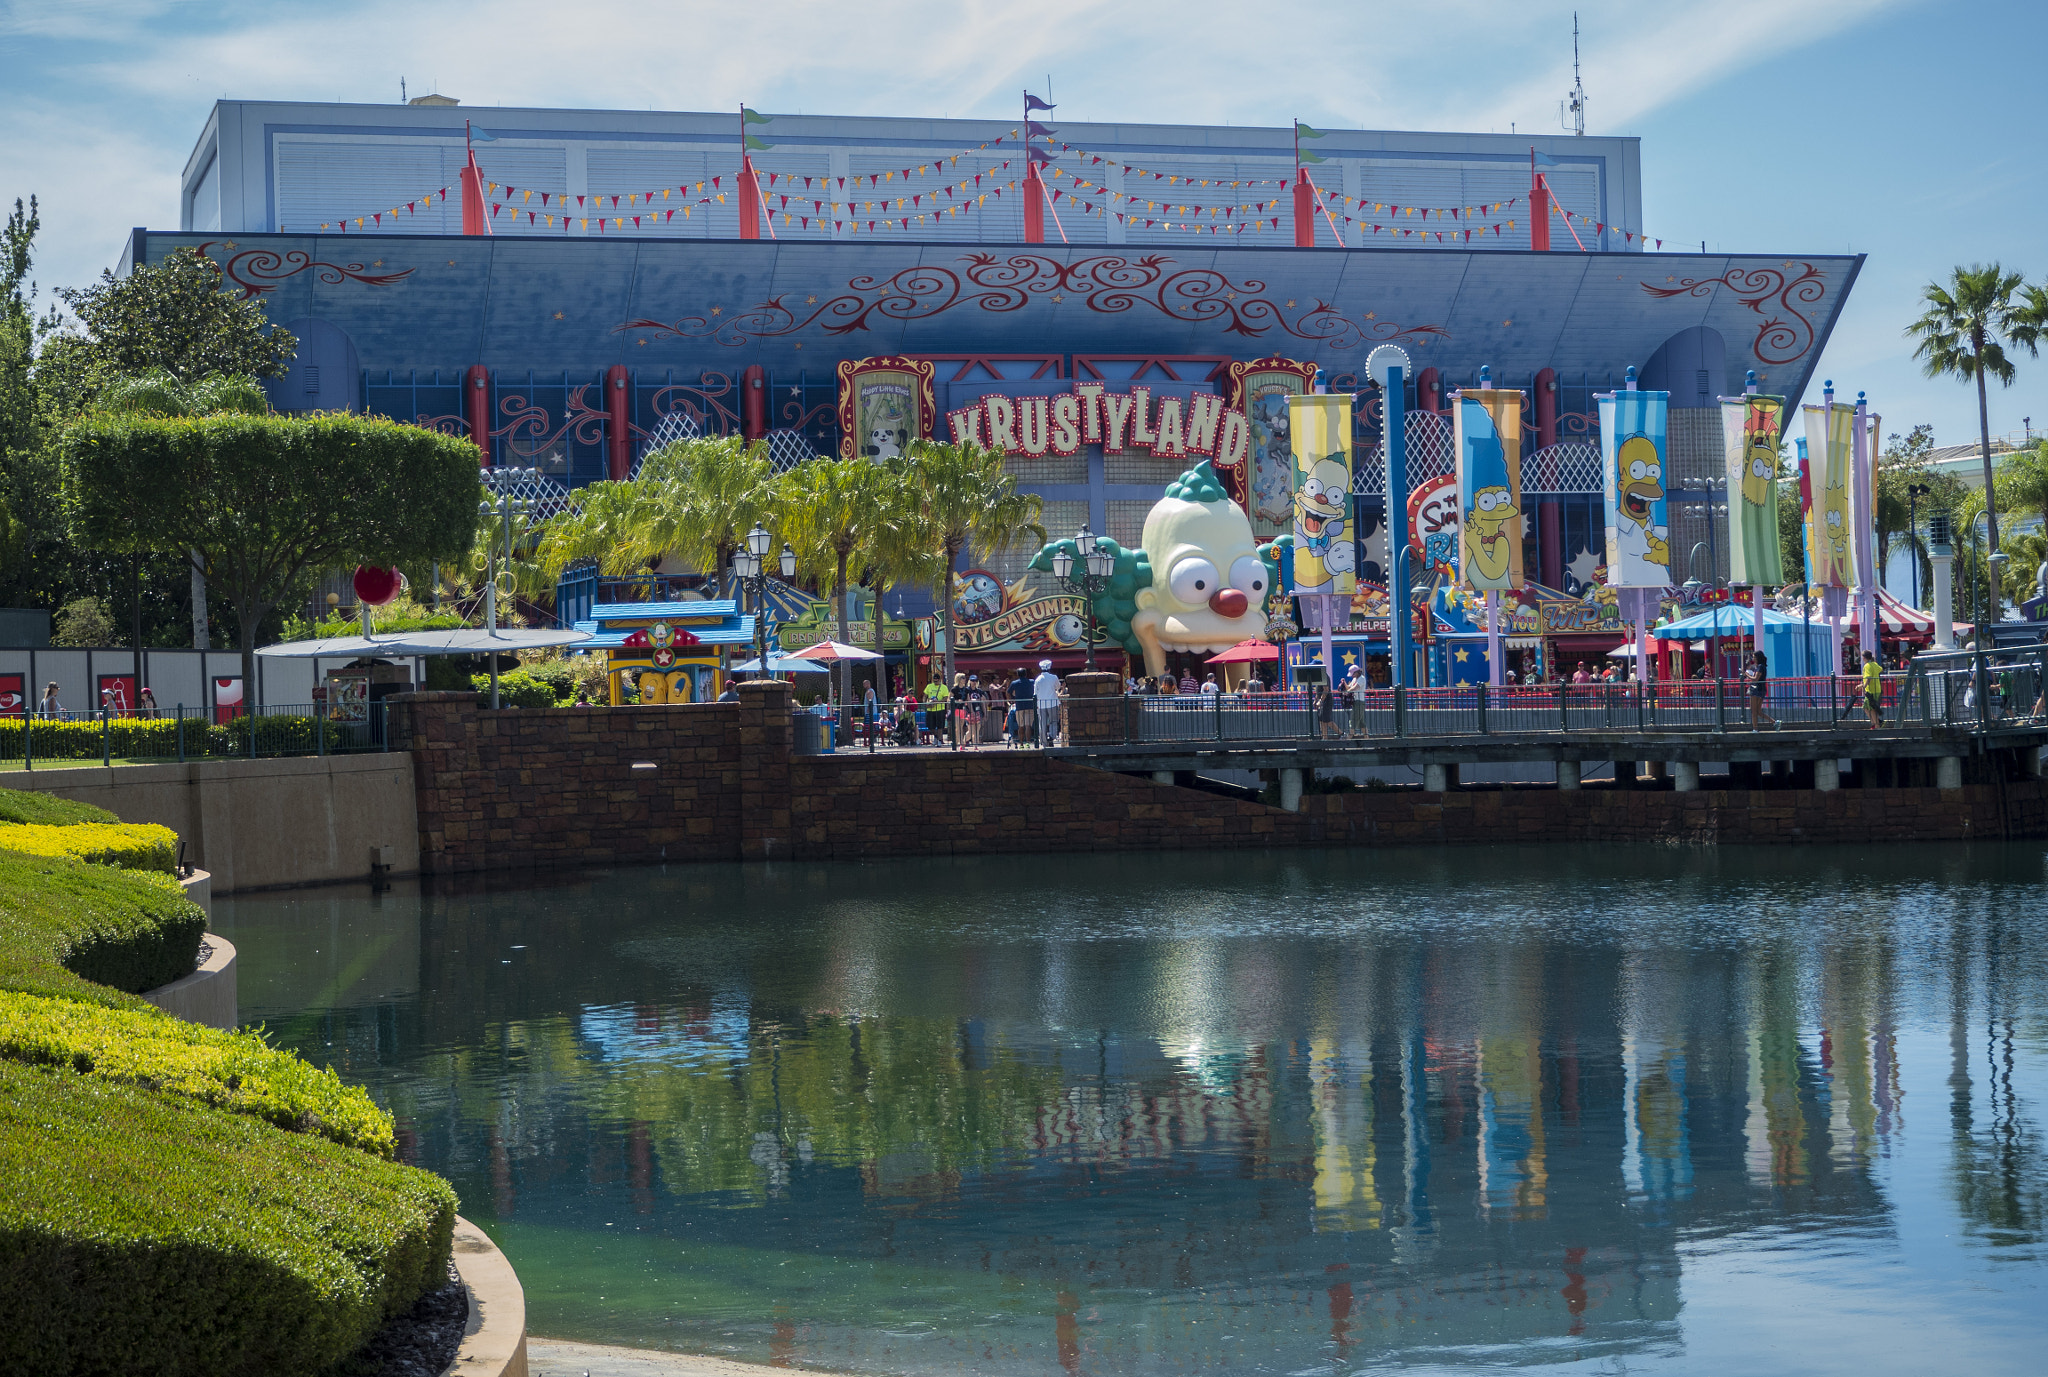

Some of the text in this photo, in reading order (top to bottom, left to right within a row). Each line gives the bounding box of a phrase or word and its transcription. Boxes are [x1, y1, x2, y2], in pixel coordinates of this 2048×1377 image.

[945, 381, 1249, 470] KRUSTYLAND
[1509, 613, 1538, 633] YOU
[1601, 617, 1620, 629] AND
[954, 625, 993, 646] EYE
